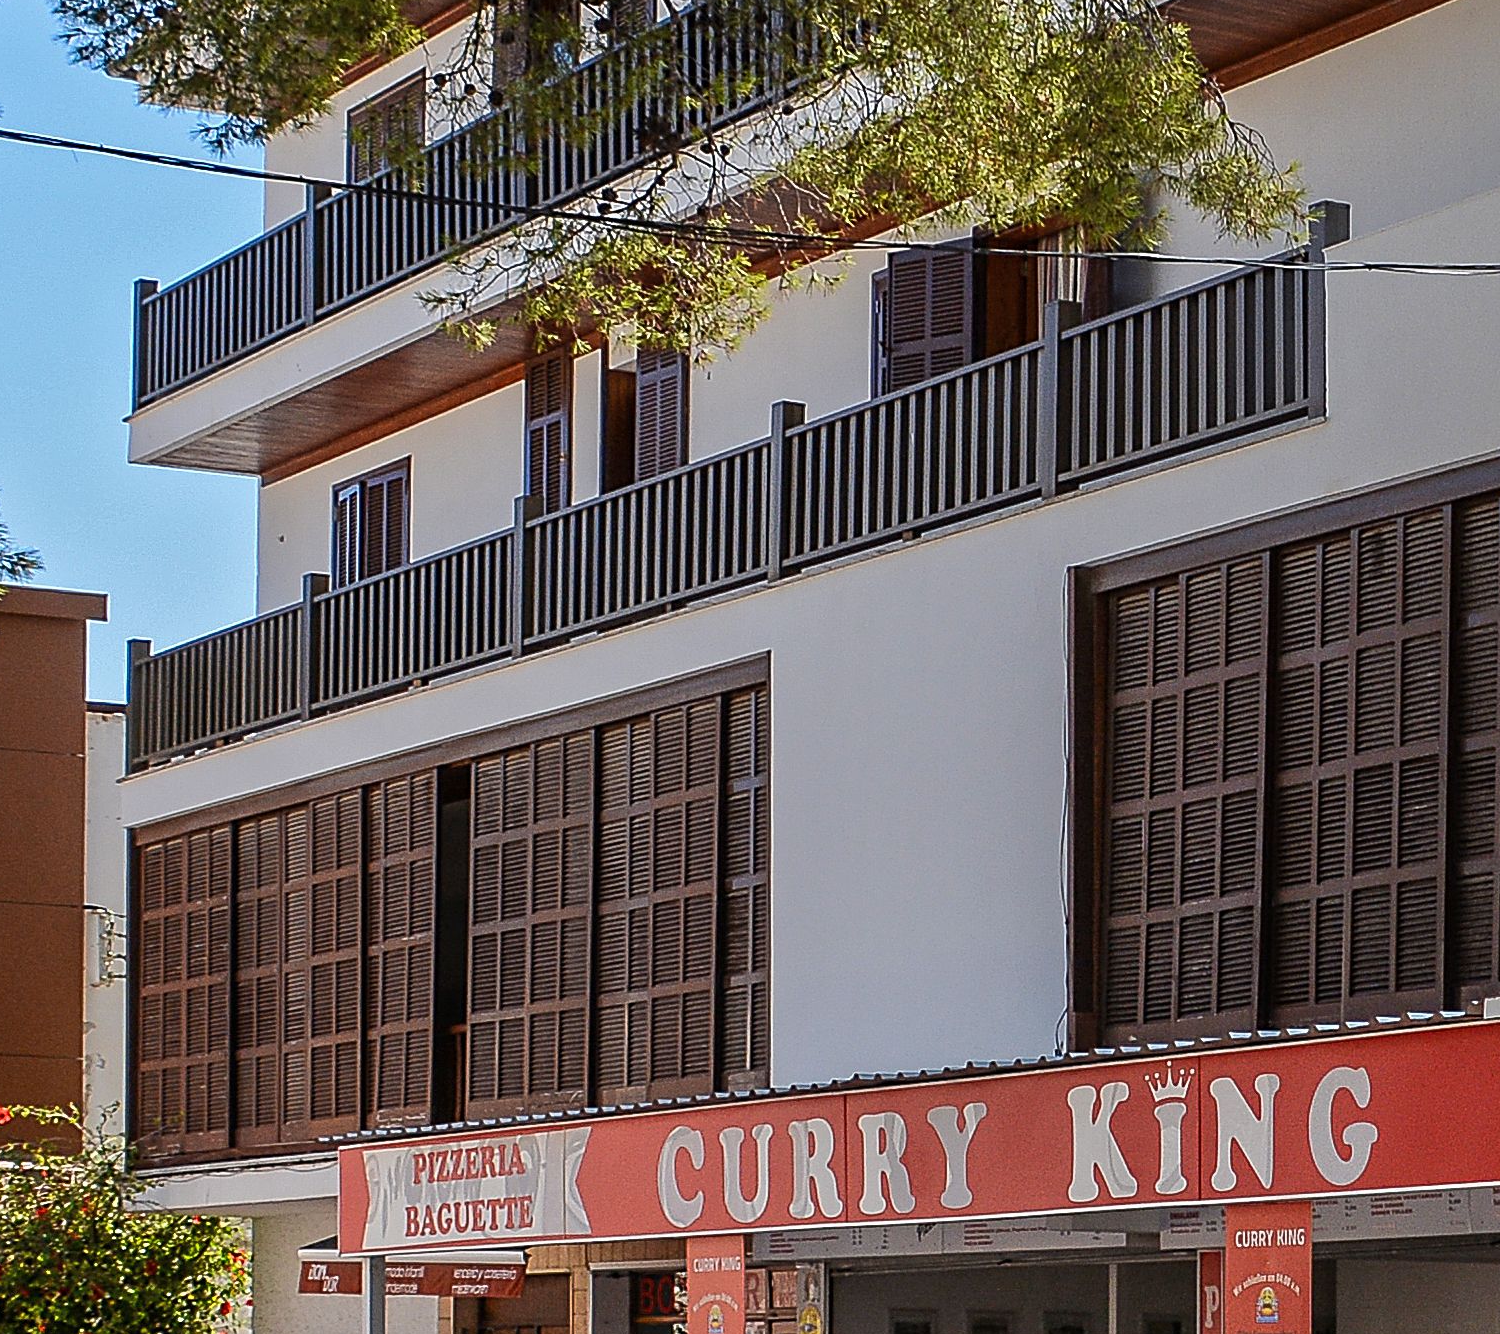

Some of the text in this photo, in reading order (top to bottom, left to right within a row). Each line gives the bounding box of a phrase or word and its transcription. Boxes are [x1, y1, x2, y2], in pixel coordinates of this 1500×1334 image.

[412, 1142, 527, 1186] PIZZERIA
[656, 1065, 1379, 1229] CURRY KING
[405, 1195, 534, 1239] BAGUETTE
[1235, 1228, 1305, 1248] CURRY KING
[693, 1256, 741, 1273] CURRY KING
